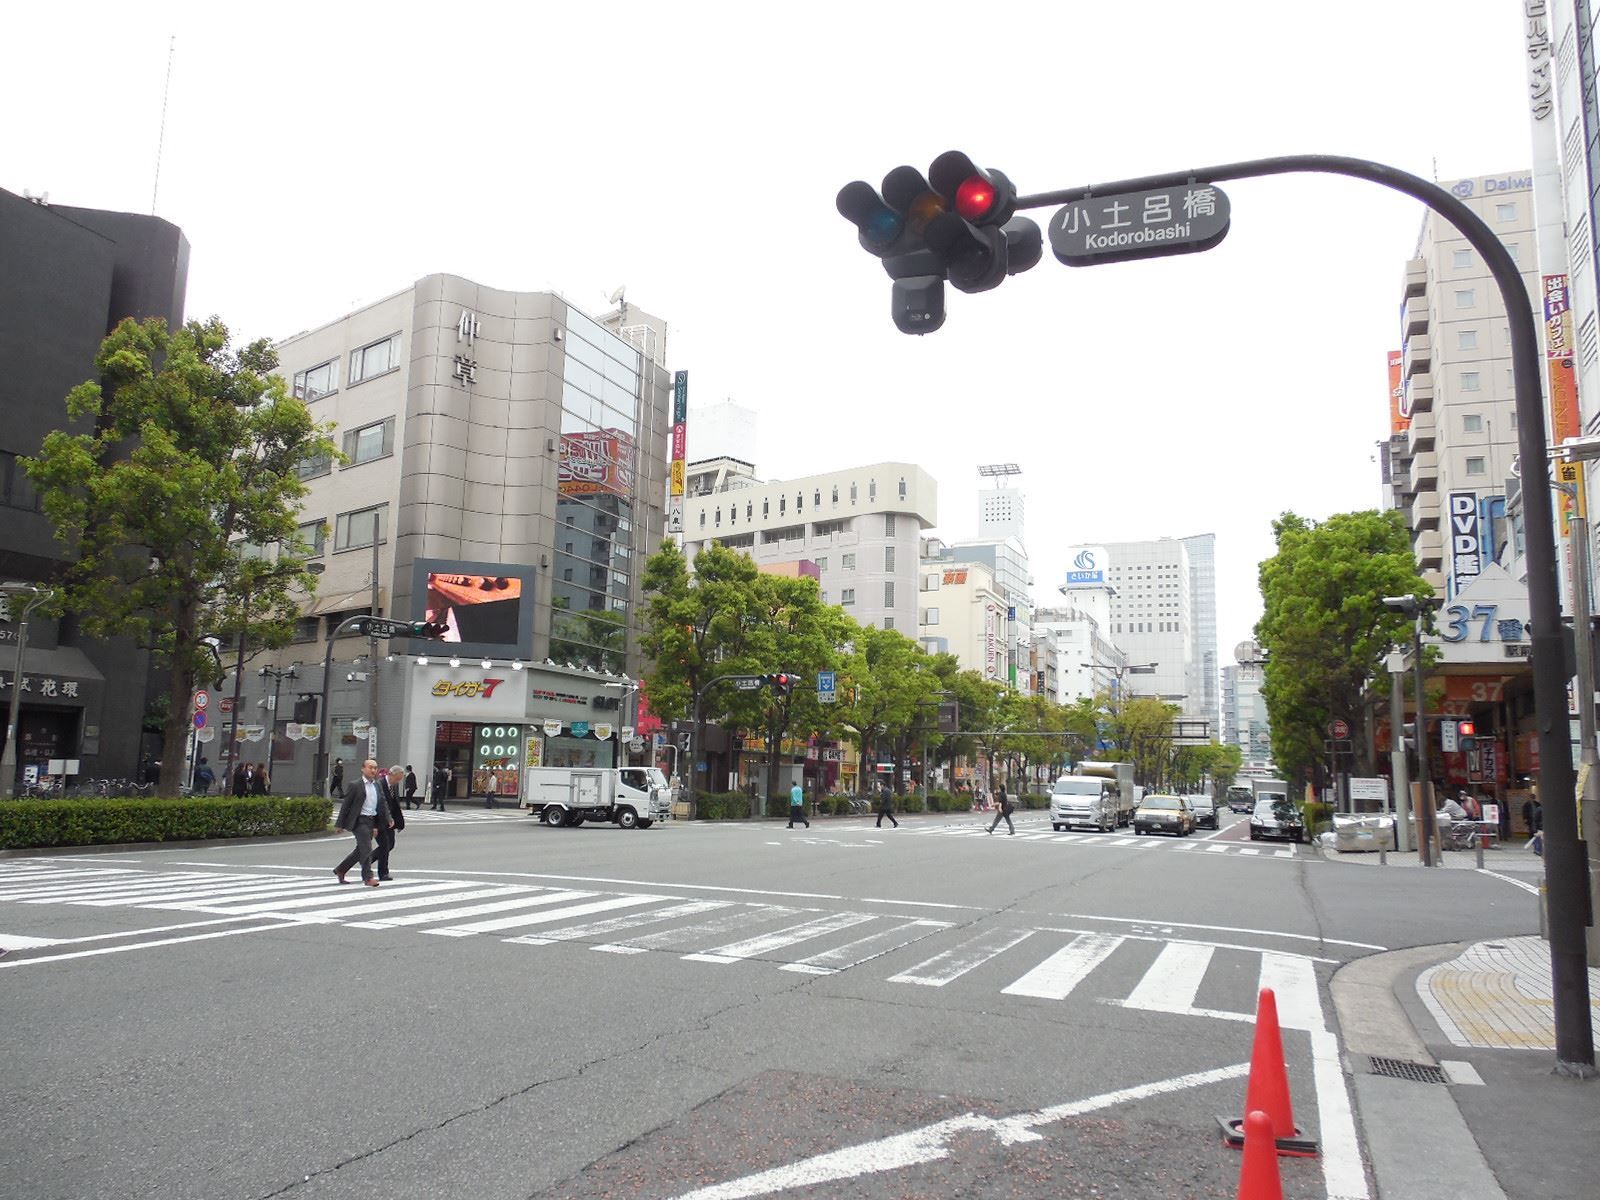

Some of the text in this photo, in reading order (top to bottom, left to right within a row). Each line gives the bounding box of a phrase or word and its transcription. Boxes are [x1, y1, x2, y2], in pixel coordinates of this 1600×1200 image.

[1061, 188, 1217, 235] 小土呂橋
[1085, 222, 1191, 249] Kodorobashi
[40, 679, 79, 697] 花環
[431, 678, 505, 698] タイガー7
[1472, 682, 1503, 702] 37
